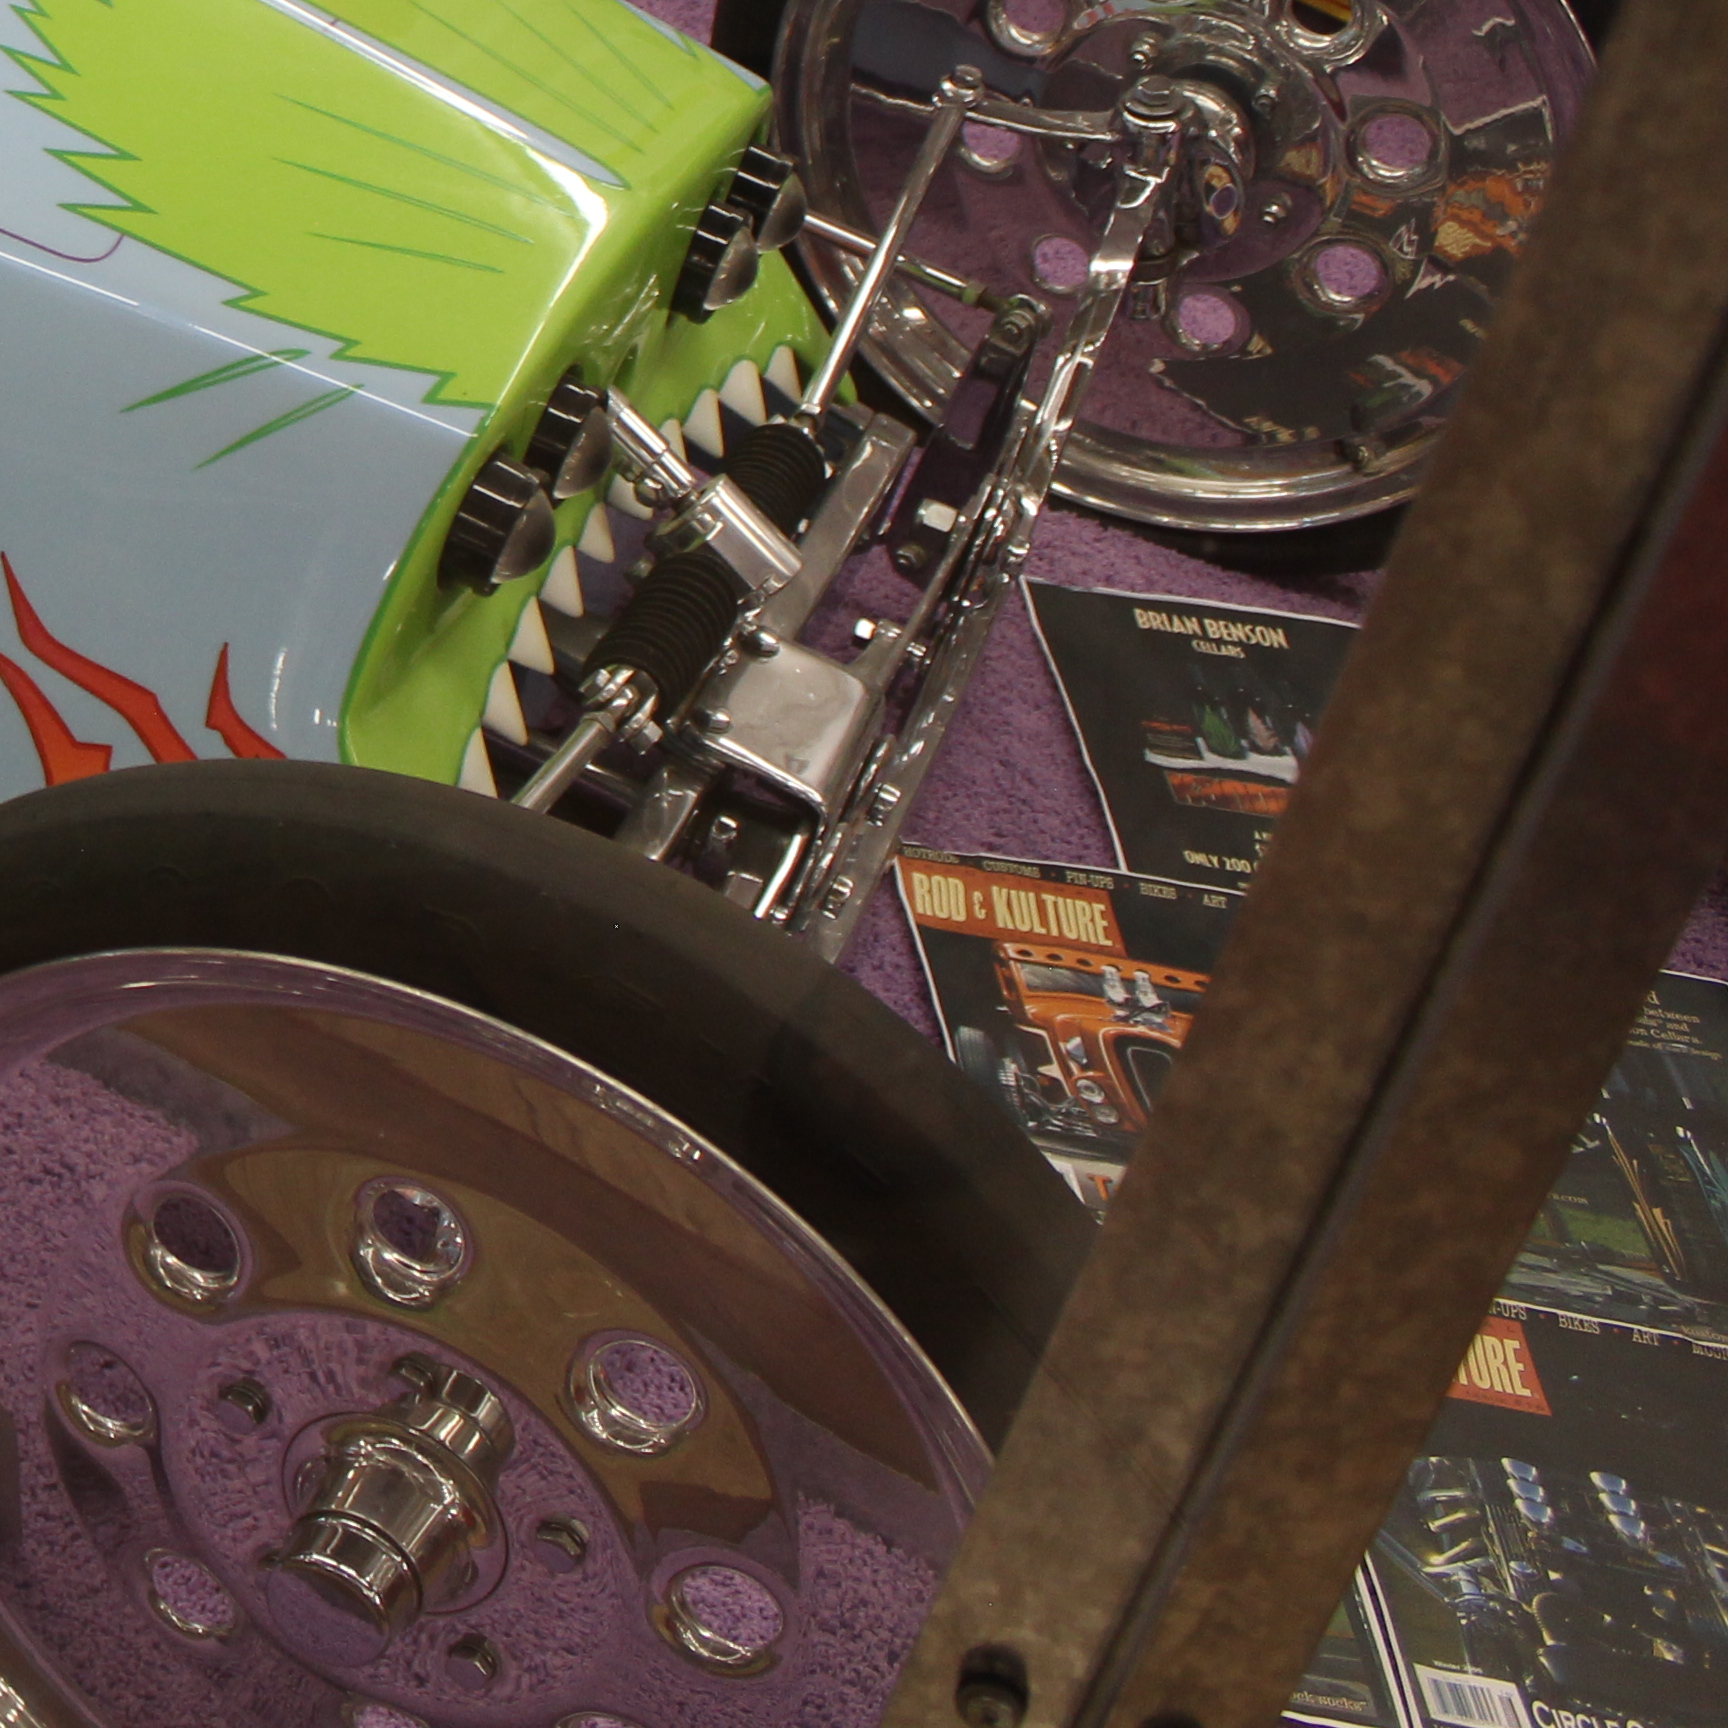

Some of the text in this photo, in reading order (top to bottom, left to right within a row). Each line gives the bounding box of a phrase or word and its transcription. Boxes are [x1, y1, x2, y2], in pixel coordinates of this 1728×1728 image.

[1132, 607, 1291, 650] BRIAN BENSON
[1191, 639, 1247, 659] CELLARS
[911, 871, 967, 923] ROD
[991, 884, 1114, 948] KULTURE
[1202, 893, 1229, 910] ART
[1558, 1312, 1601, 1335] BIKES
[1631, 1328, 1661, 1347] ART
